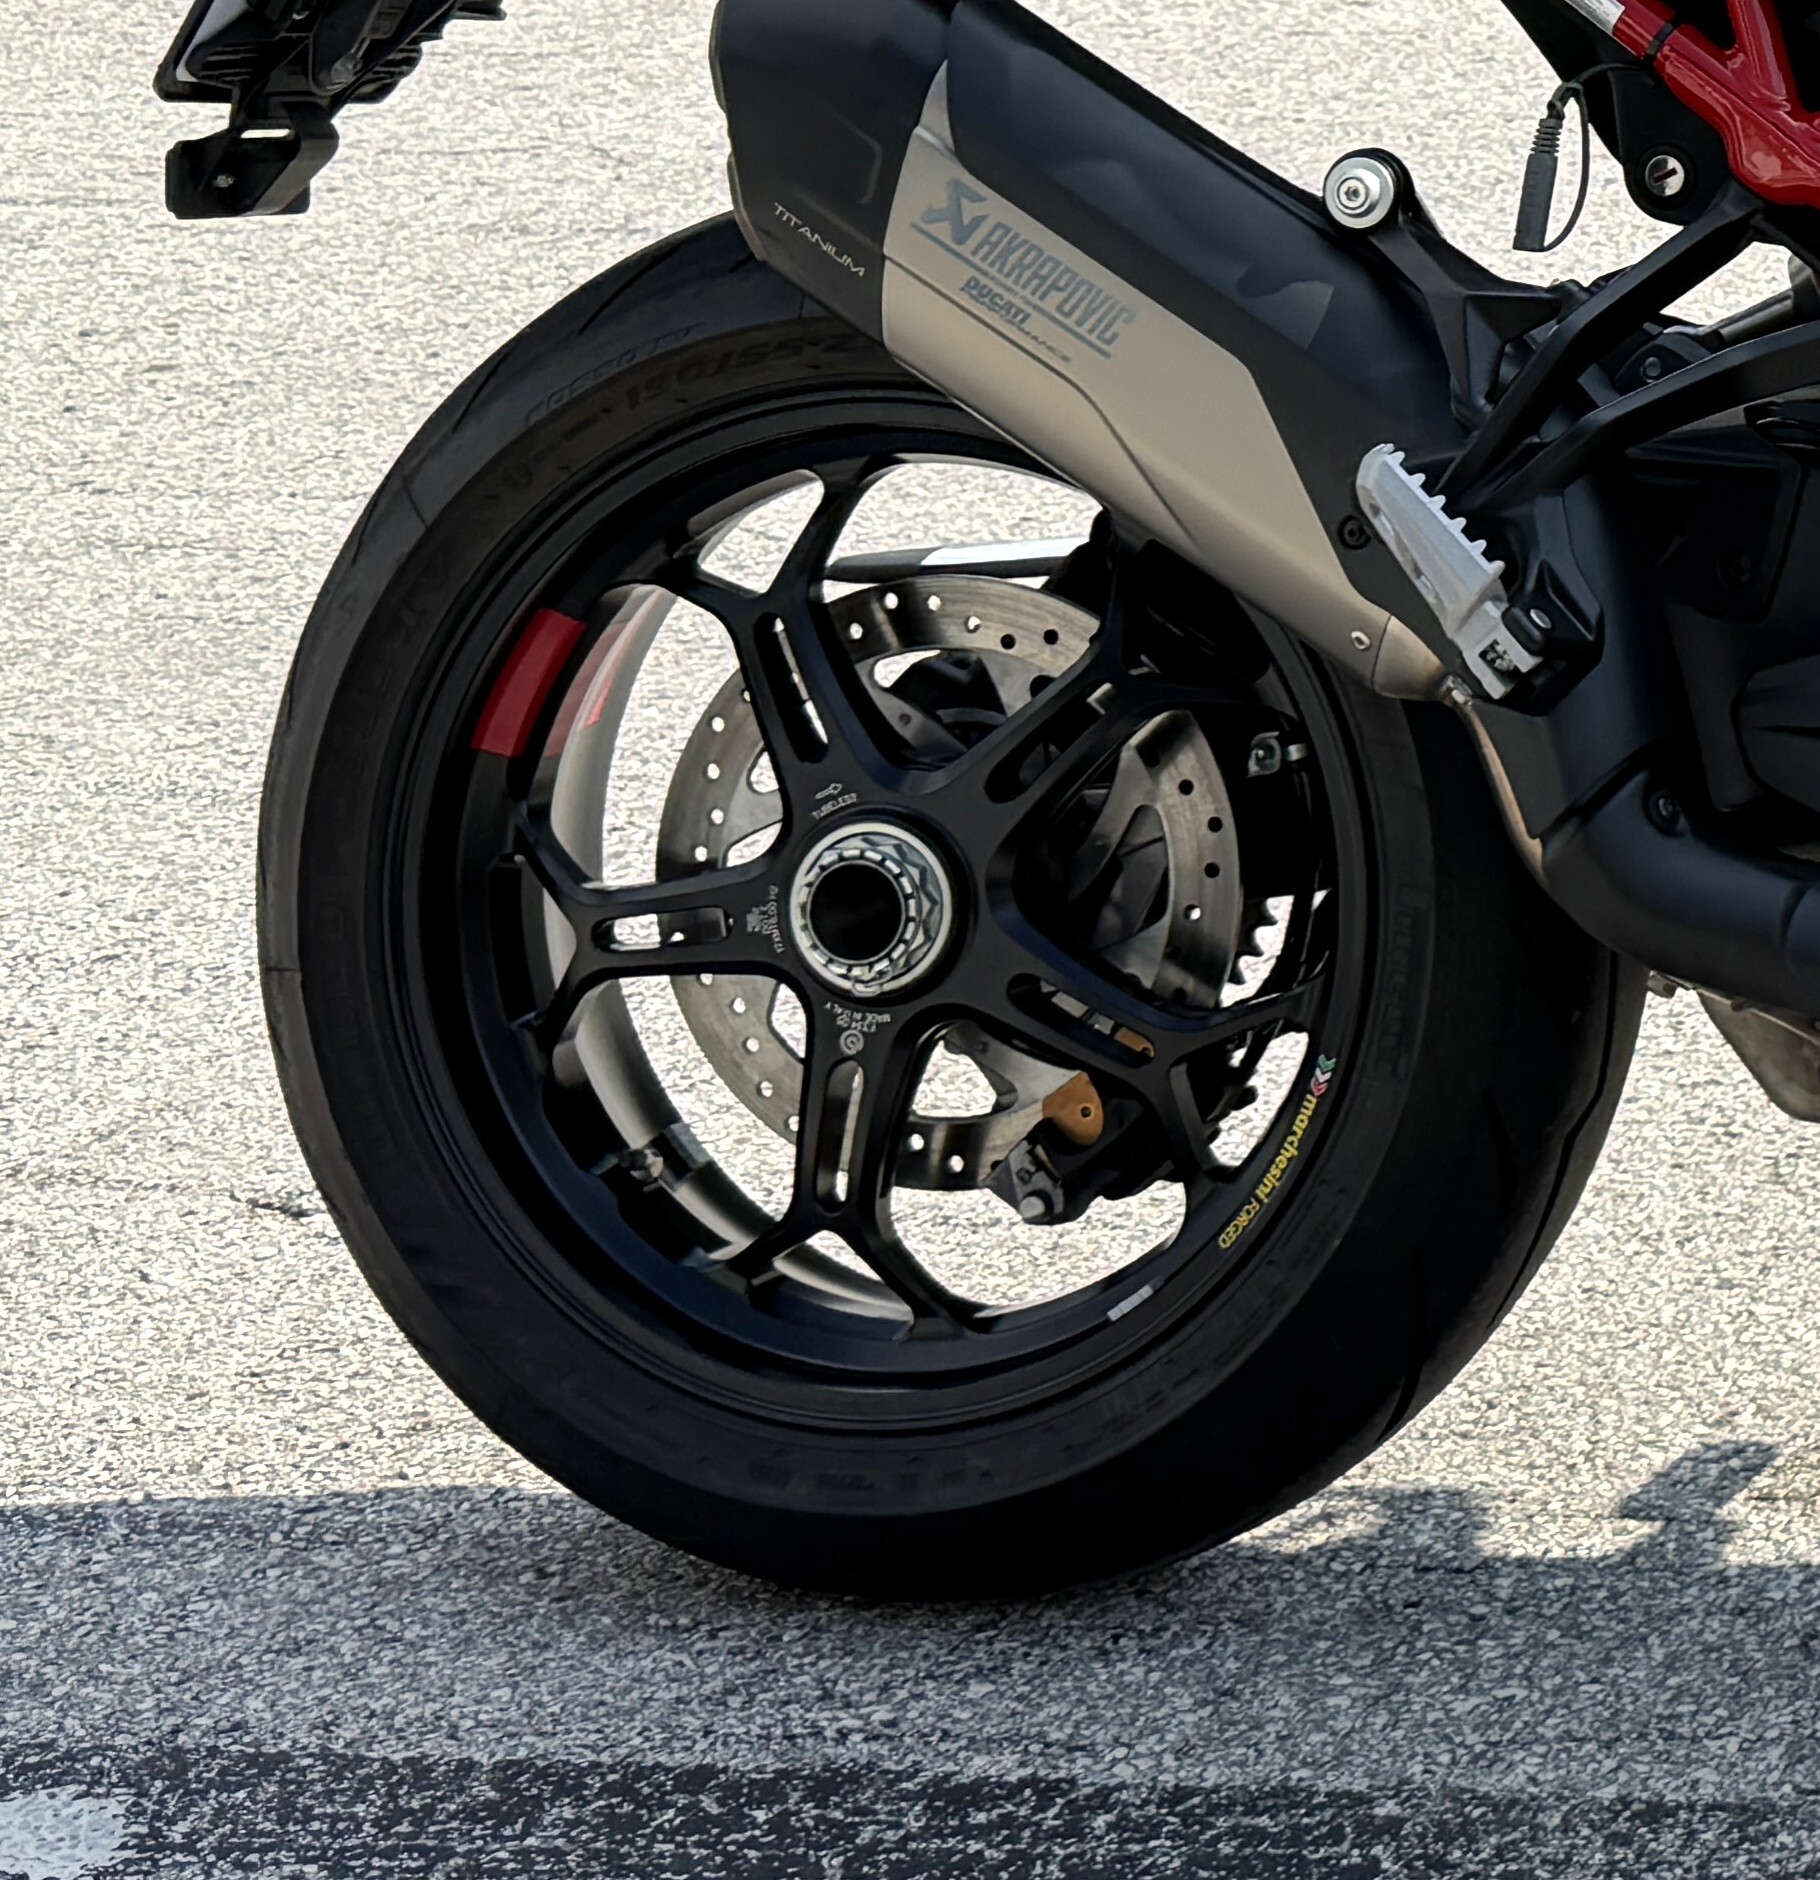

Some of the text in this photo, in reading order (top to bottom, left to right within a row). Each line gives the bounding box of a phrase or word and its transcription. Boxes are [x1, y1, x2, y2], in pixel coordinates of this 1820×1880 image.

[773, 202, 866, 278] TITANIUM
[961, 275, 1032, 325] DUCATI
[1218, 1094, 1317, 1249] marchesini FORGED
